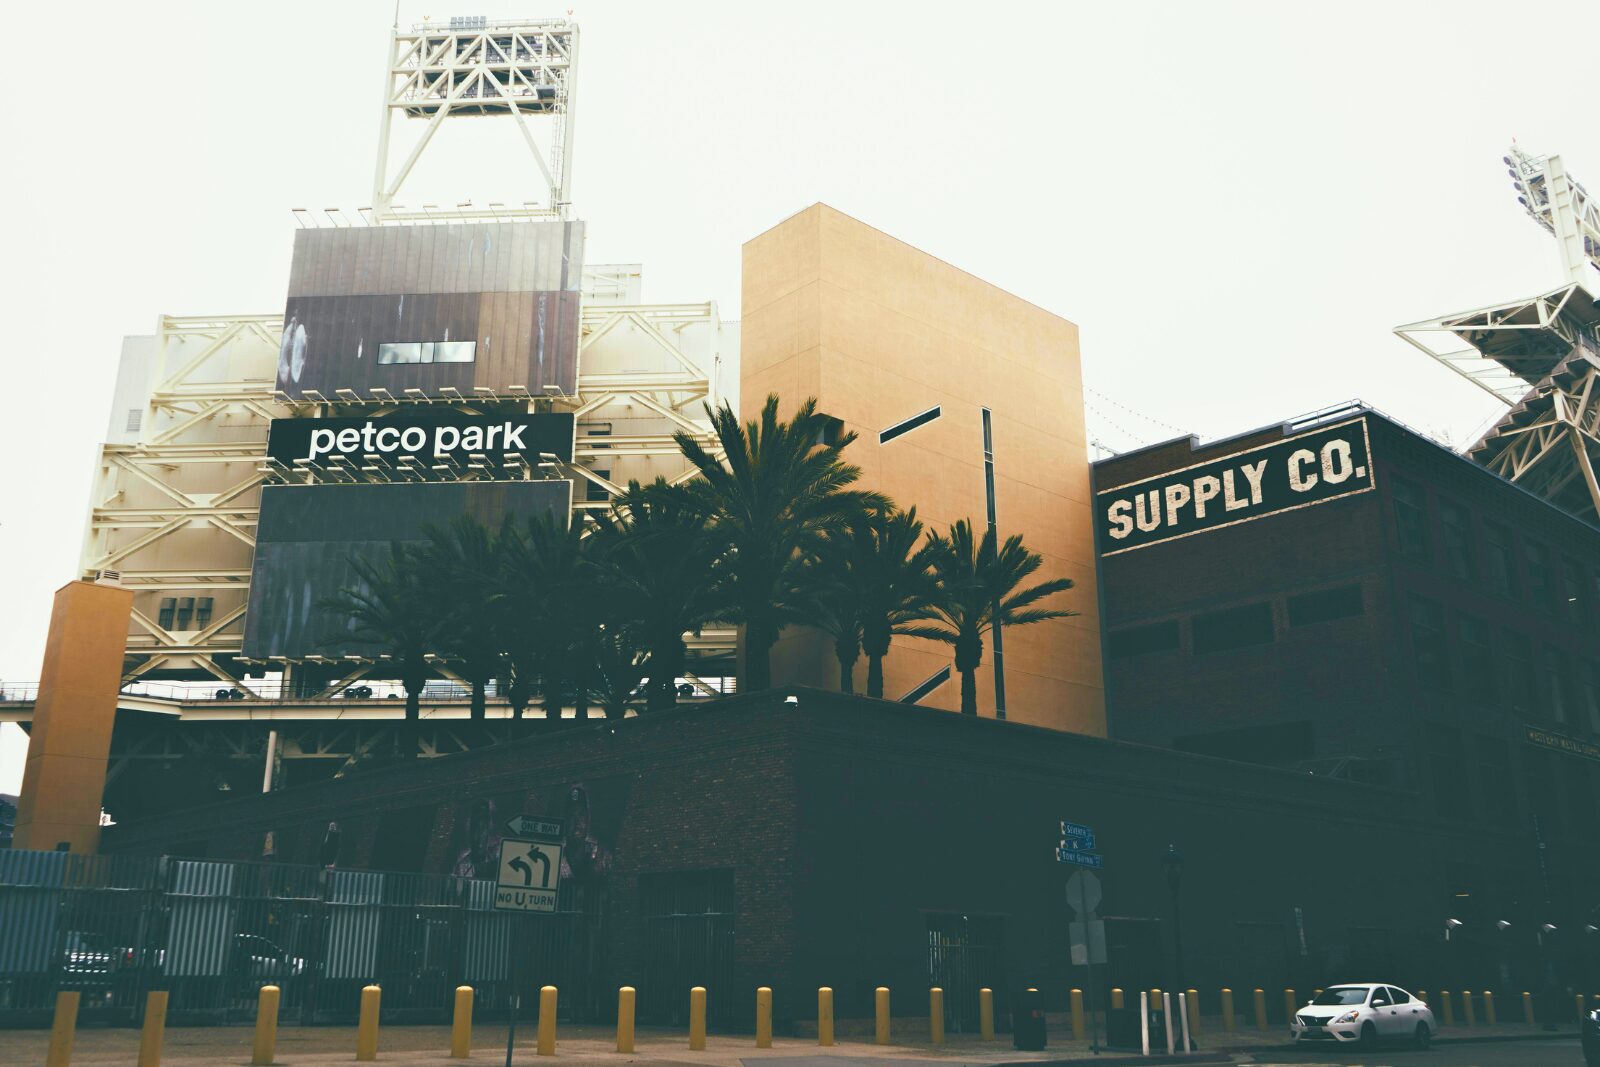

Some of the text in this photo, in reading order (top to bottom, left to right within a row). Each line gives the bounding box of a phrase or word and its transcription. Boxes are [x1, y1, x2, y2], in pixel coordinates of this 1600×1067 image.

[308, 421, 529, 460] petco park
[1107, 438, 1366, 540] SUPPLY CO.
[521, 822, 559, 833] ONE WAY
[1073, 840, 1079, 849] K
[497, 892, 554, 906] NO U TURN
